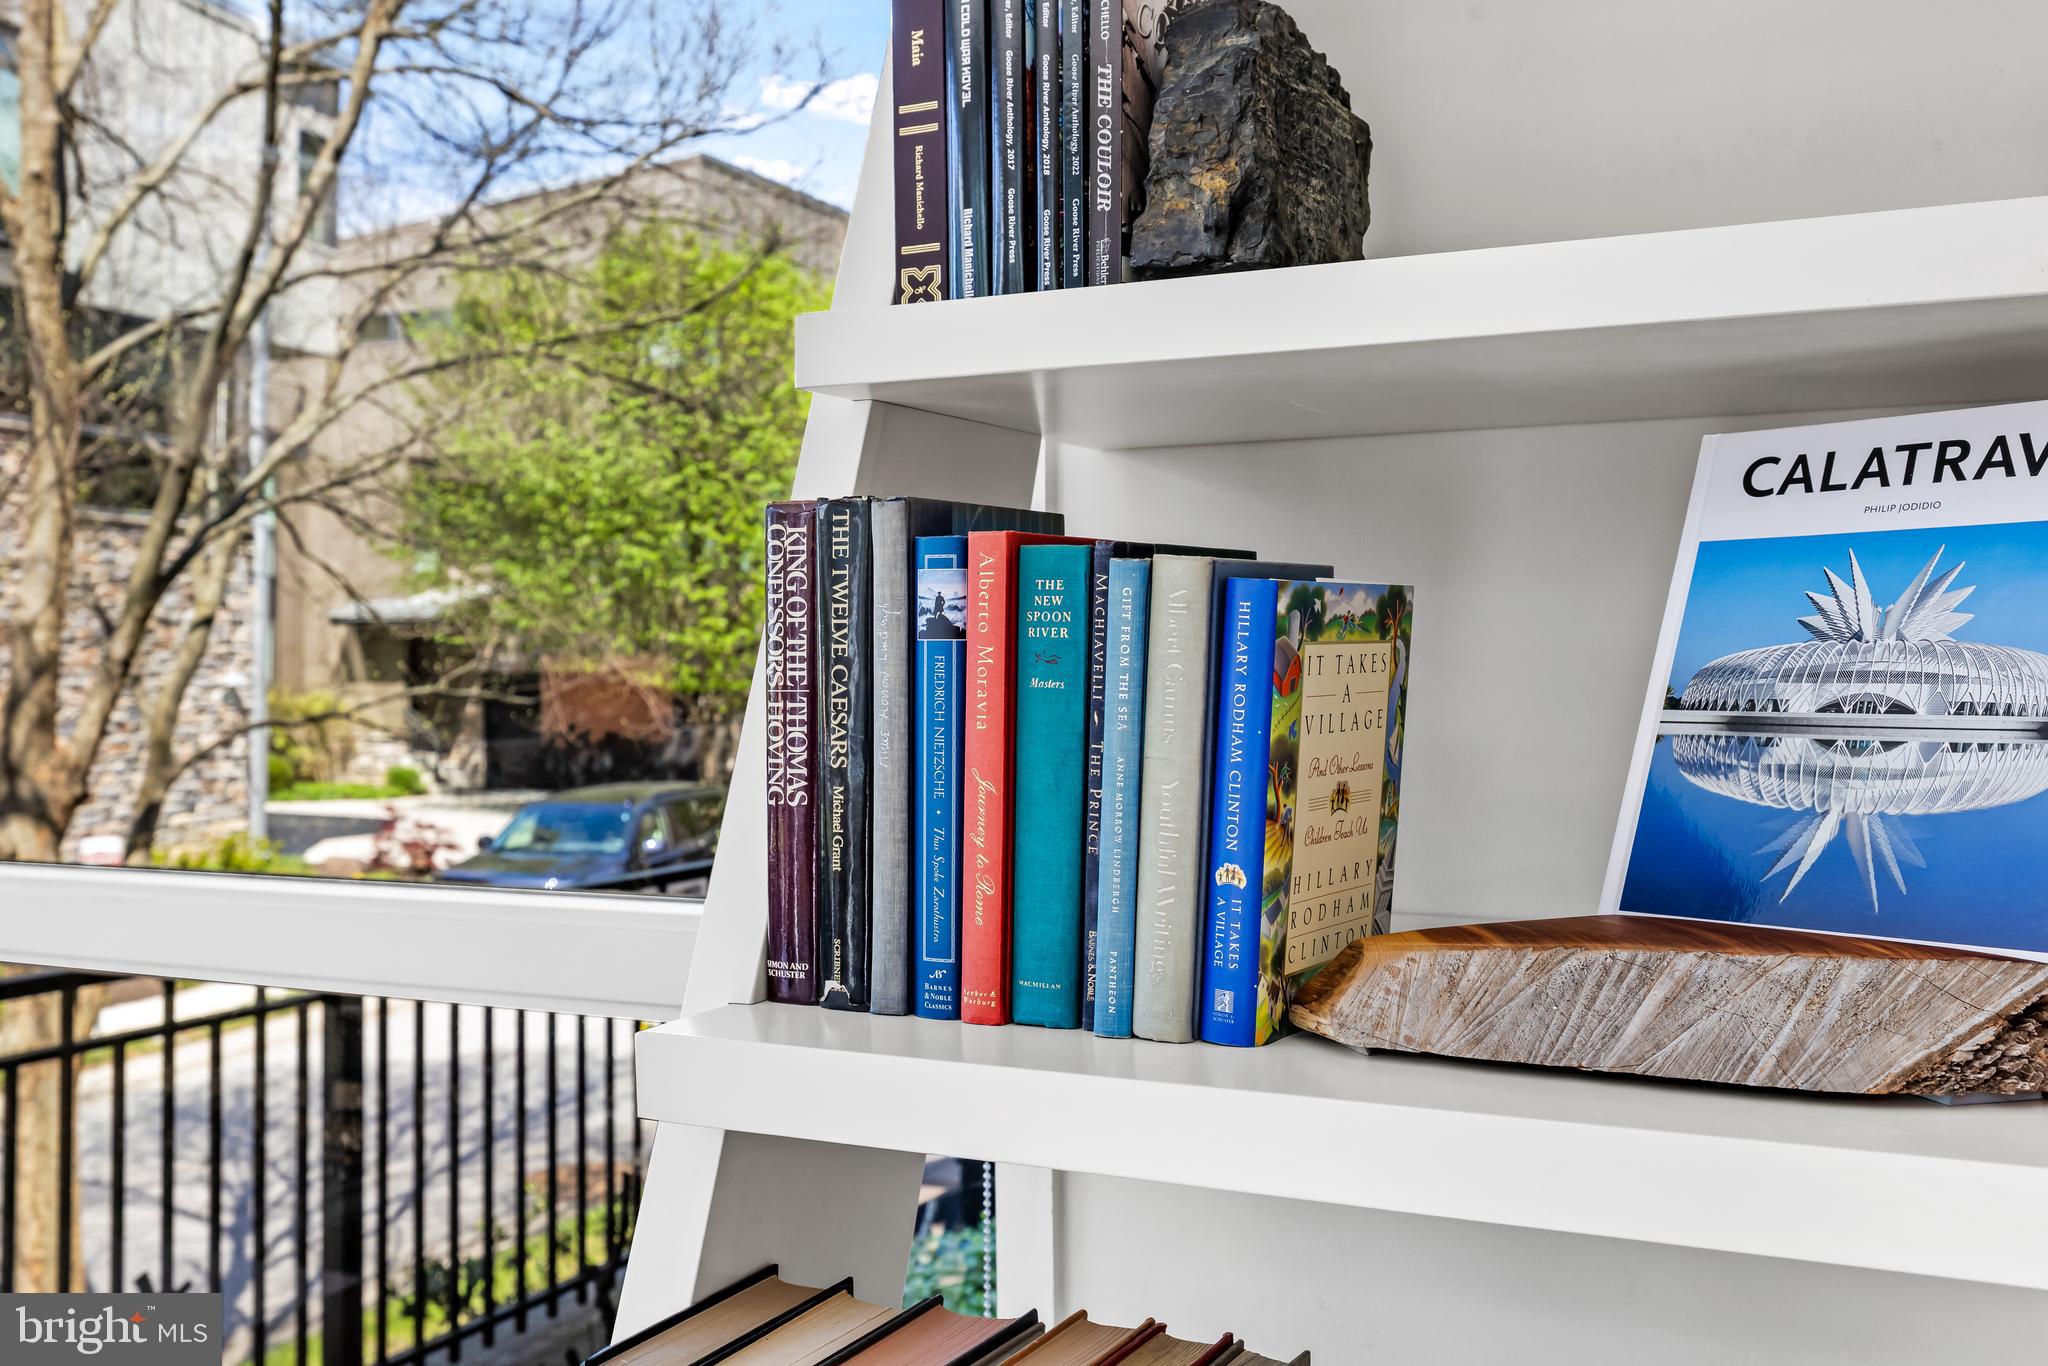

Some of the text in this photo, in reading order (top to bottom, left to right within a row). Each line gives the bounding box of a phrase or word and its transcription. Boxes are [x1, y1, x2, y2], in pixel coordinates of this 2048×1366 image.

[961, 4, 971, 37] COLD
[1005, 13, 1013, 39] Editor
[1042, 2, 1050, 28] Editor
[1071, 6, 1079, 34] Editor
[911, 29, 924, 67] Maia
[1005, 50, 1015, 171] Goose River Anthology, 2017
[1042, 54, 1051, 176] Goose River Anthology, 2018
[1069, 54, 1080, 176] Goose River Anthology, 2022
[1097, 64, 1113, 212] THE COULOIR
[915, 145, 925, 230] Richard Manichello
[1008, 215, 1016, 239] River
[1072, 198, 1080, 277] Goose River Press
[963, 208, 975, 297] Richard Manichell
[1008, 240, 1016, 264] Press
[1043, 209, 1052, 286] Goose River Press
[1100, 254, 1110, 285] Behler
[1864, 500, 1942, 514] PHILIP JODIDIO
[1034, 595, 1064, 606] NEW
[1035, 580, 1065, 591] THE
[766, 524, 786, 687] CONFESSORS
[786, 525, 808, 687] KING OF THE
[1026, 611, 1072, 623] SPOON
[1166, 589, 1188, 654] Albert
[830, 509, 850, 769] THE TWELVE CAESARS
[976, 552, 995, 730] Alberto Moravia
[1028, 627, 1069, 639] RIVER
[1117, 587, 1132, 731] GIFT FROM THE SEA
[1307, 652, 1388, 677] IT TAKES
[1029, 677, 1065, 689] Masters
[1342, 684, 1351, 704] A
[933, 655, 946, 799] FRIEDRICH NIETZSCHE
[1088, 573, 1108, 854] MACHIAVELLI THE PRINCE
[1225, 601, 1251, 851] HILLARY RODHAM CLINTON
[1304, 708, 1384, 736] VILLAGE
[767, 700, 785, 807] HOVING
[786, 697, 808, 807] THOMAS
[1308, 751, 1374, 779] And Other Lessons
[832, 786, 844, 872] Michael Grant
[933, 828, 945, 851] Thus
[971, 767, 997, 927] Journey to Rome
[1111, 756, 1124, 913] ANNE MORROW LINDBERGH
[1304, 816, 1368, 847] Children Teach Us
[931, 855, 945, 883] Spoke
[1293, 859, 1373, 895] HILLARY
[1290, 892, 1370, 930] RODHAM
[1087, 930, 1097, 961] BARNES
[1213, 896, 1226, 968] A VILLAGE
[1227, 899, 1242, 970] IT TAKES
[1288, 924, 1368, 964] CLINTON
[767, 960, 809, 971] SIMON AND
[768, 969, 806, 979] SCHUSTER
[1108, 951, 1117, 1014] PANTHEON
[924, 983, 952, 992] BARNES
[1018, 980, 1062, 990] MACMILLAN
[924, 1002, 952, 1011] CLASSICS
